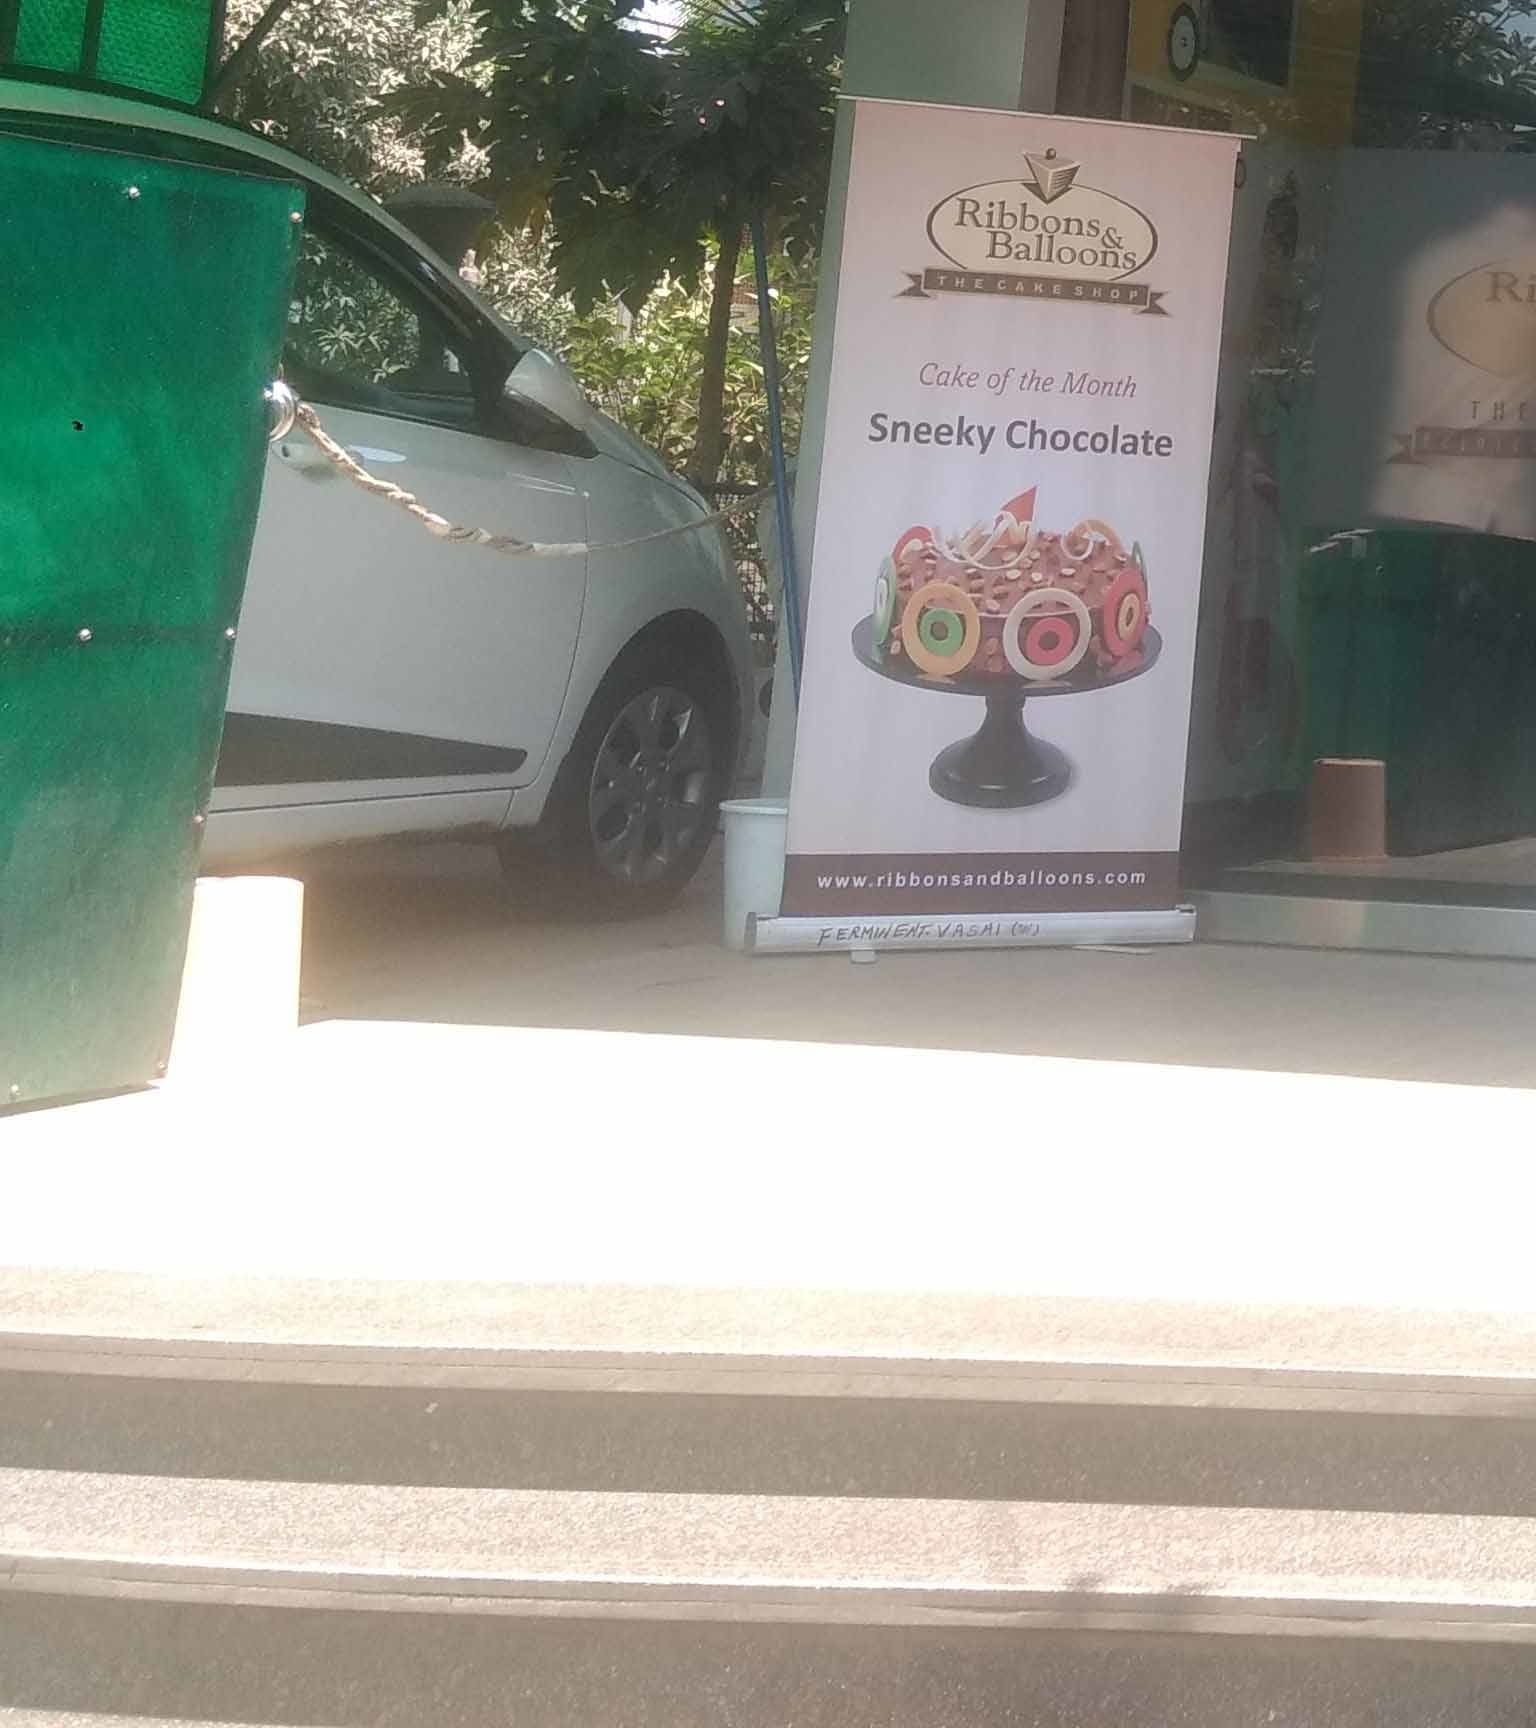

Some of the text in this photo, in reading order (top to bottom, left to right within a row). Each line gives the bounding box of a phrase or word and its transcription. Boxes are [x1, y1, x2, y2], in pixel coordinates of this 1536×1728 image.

[954, 197, 1125, 250] Ribbons &
[984, 230, 1138, 270] Balloons
[937, 275, 1139, 302] THE CAKE SHOP
[918, 361, 1138, 399] Cake of the Month
[867, 412, 1174, 458] Sneeky Chocolate
[817, 870, 1147, 890] www.ribbonsandballoons.com
